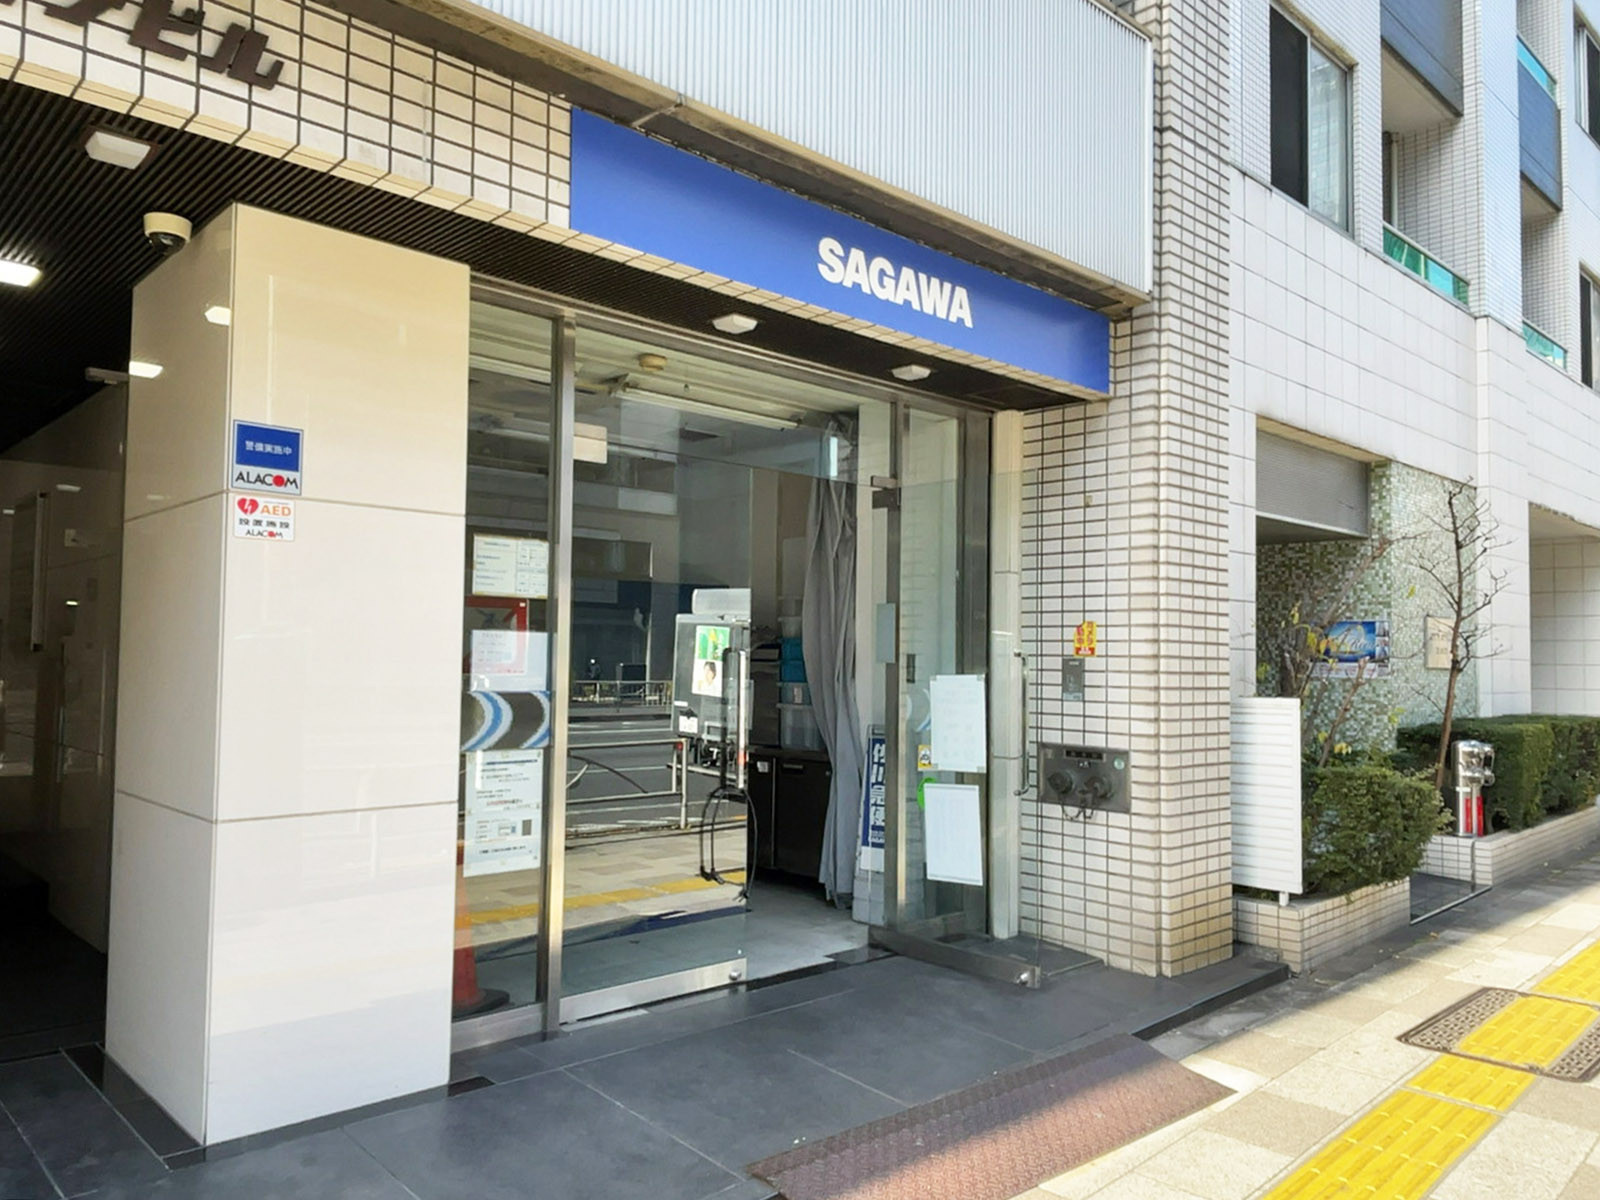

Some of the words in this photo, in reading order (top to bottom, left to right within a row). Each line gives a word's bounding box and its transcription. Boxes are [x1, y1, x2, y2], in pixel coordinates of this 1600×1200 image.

[817, 237, 973, 329] SAGAWA
[235, 471, 299, 489] ALACOM
[260, 504, 292, 517] AED
[245, 529, 284, 539] ALACOM
